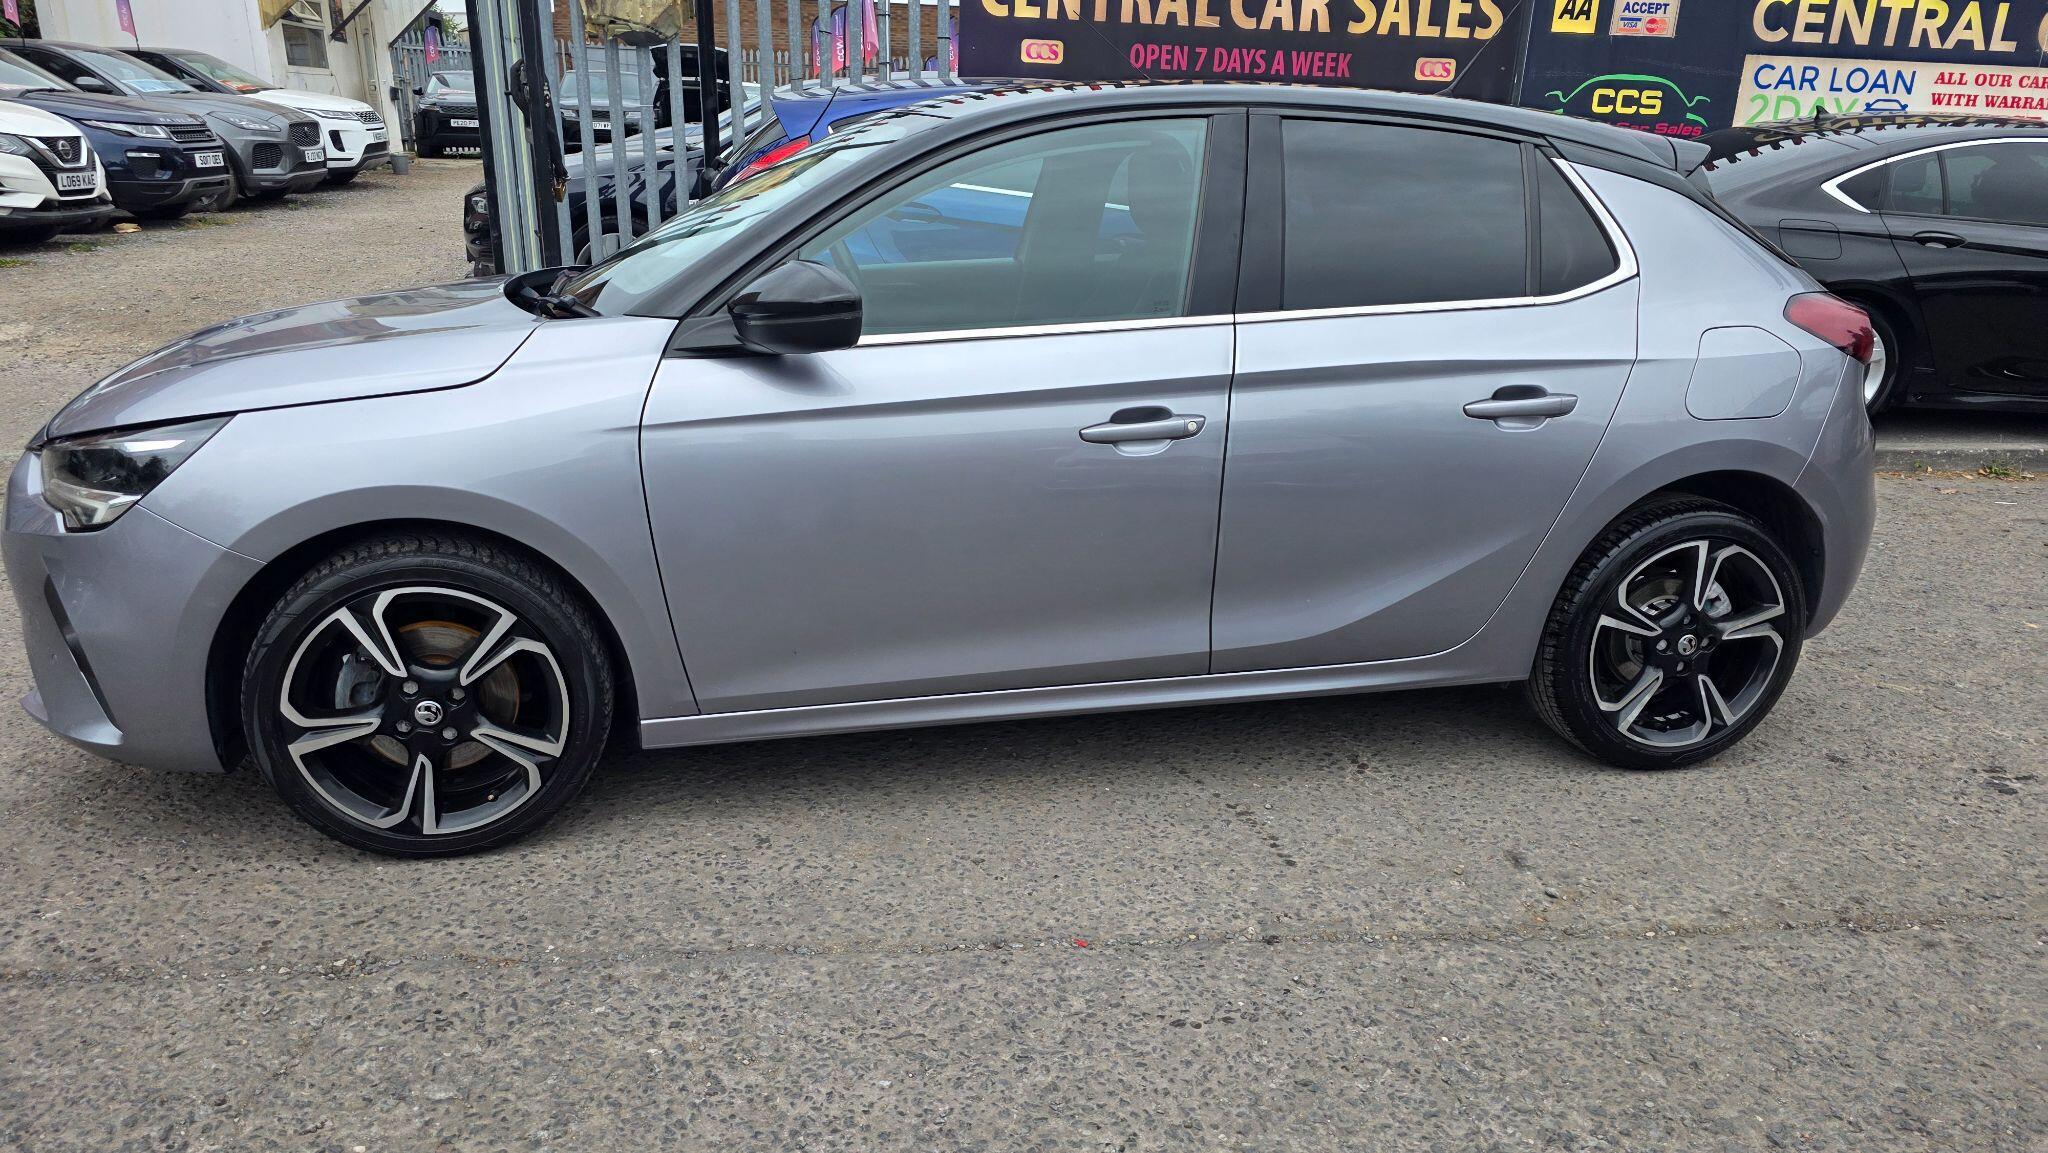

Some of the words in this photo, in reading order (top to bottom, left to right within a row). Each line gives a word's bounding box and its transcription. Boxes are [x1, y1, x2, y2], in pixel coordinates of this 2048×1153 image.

[1557, 0, 1592, 21] AA
[1622, 1, 1670, 15] ACCEPT
[1231, 0, 1331, 33] CAR
[1347, 0, 1504, 40] SALES
[1622, 21, 1638, 29] VISA
[1752, 0, 2018, 53] CENTRAL
[1129, 43, 1189, 71] OPEN
[1195, 47, 1208, 72] 7
[1213, 47, 1267, 74] DAYS
[1270, 50, 1285, 76] A
[1291, 51, 1353, 78] WEEK
[1753, 63, 1820, 91] CAR
[1829, 67, 1917, 96] LOAN
[1934, 71, 1968, 86] ALL
[1974, 73, 2012, 87] OUR
[1591, 88, 1663, 115] CCS
[1931, 92, 1979, 107] WITH
[1985, 94, 2048, 110] WARRA
[1653, 122, 1703, 137] Sales
[82, 174, 96, 186] KAE
